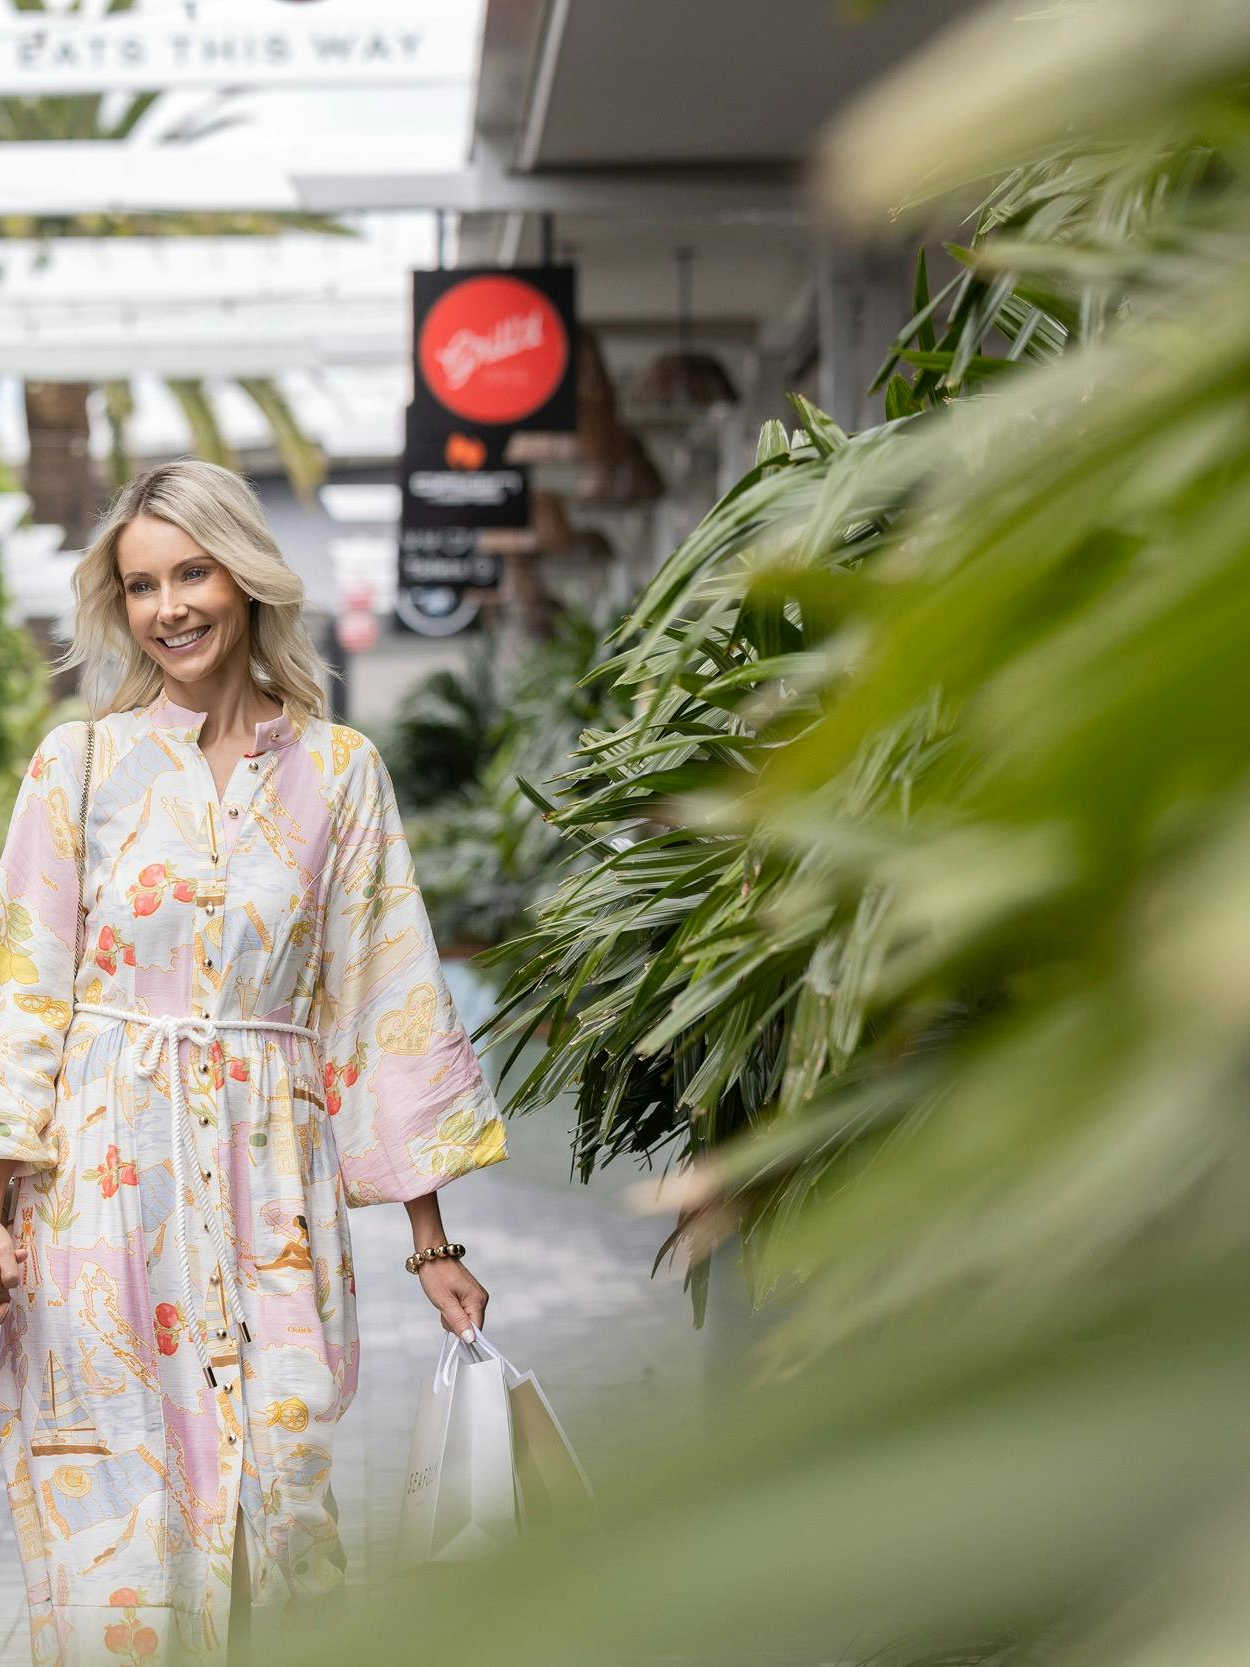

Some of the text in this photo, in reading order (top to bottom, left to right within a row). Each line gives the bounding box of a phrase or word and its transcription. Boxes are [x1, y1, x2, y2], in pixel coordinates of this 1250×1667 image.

[16, 32, 145, 69] EATS
[170, 33, 293, 66] THIS
[312, 32, 423, 64] WAY
